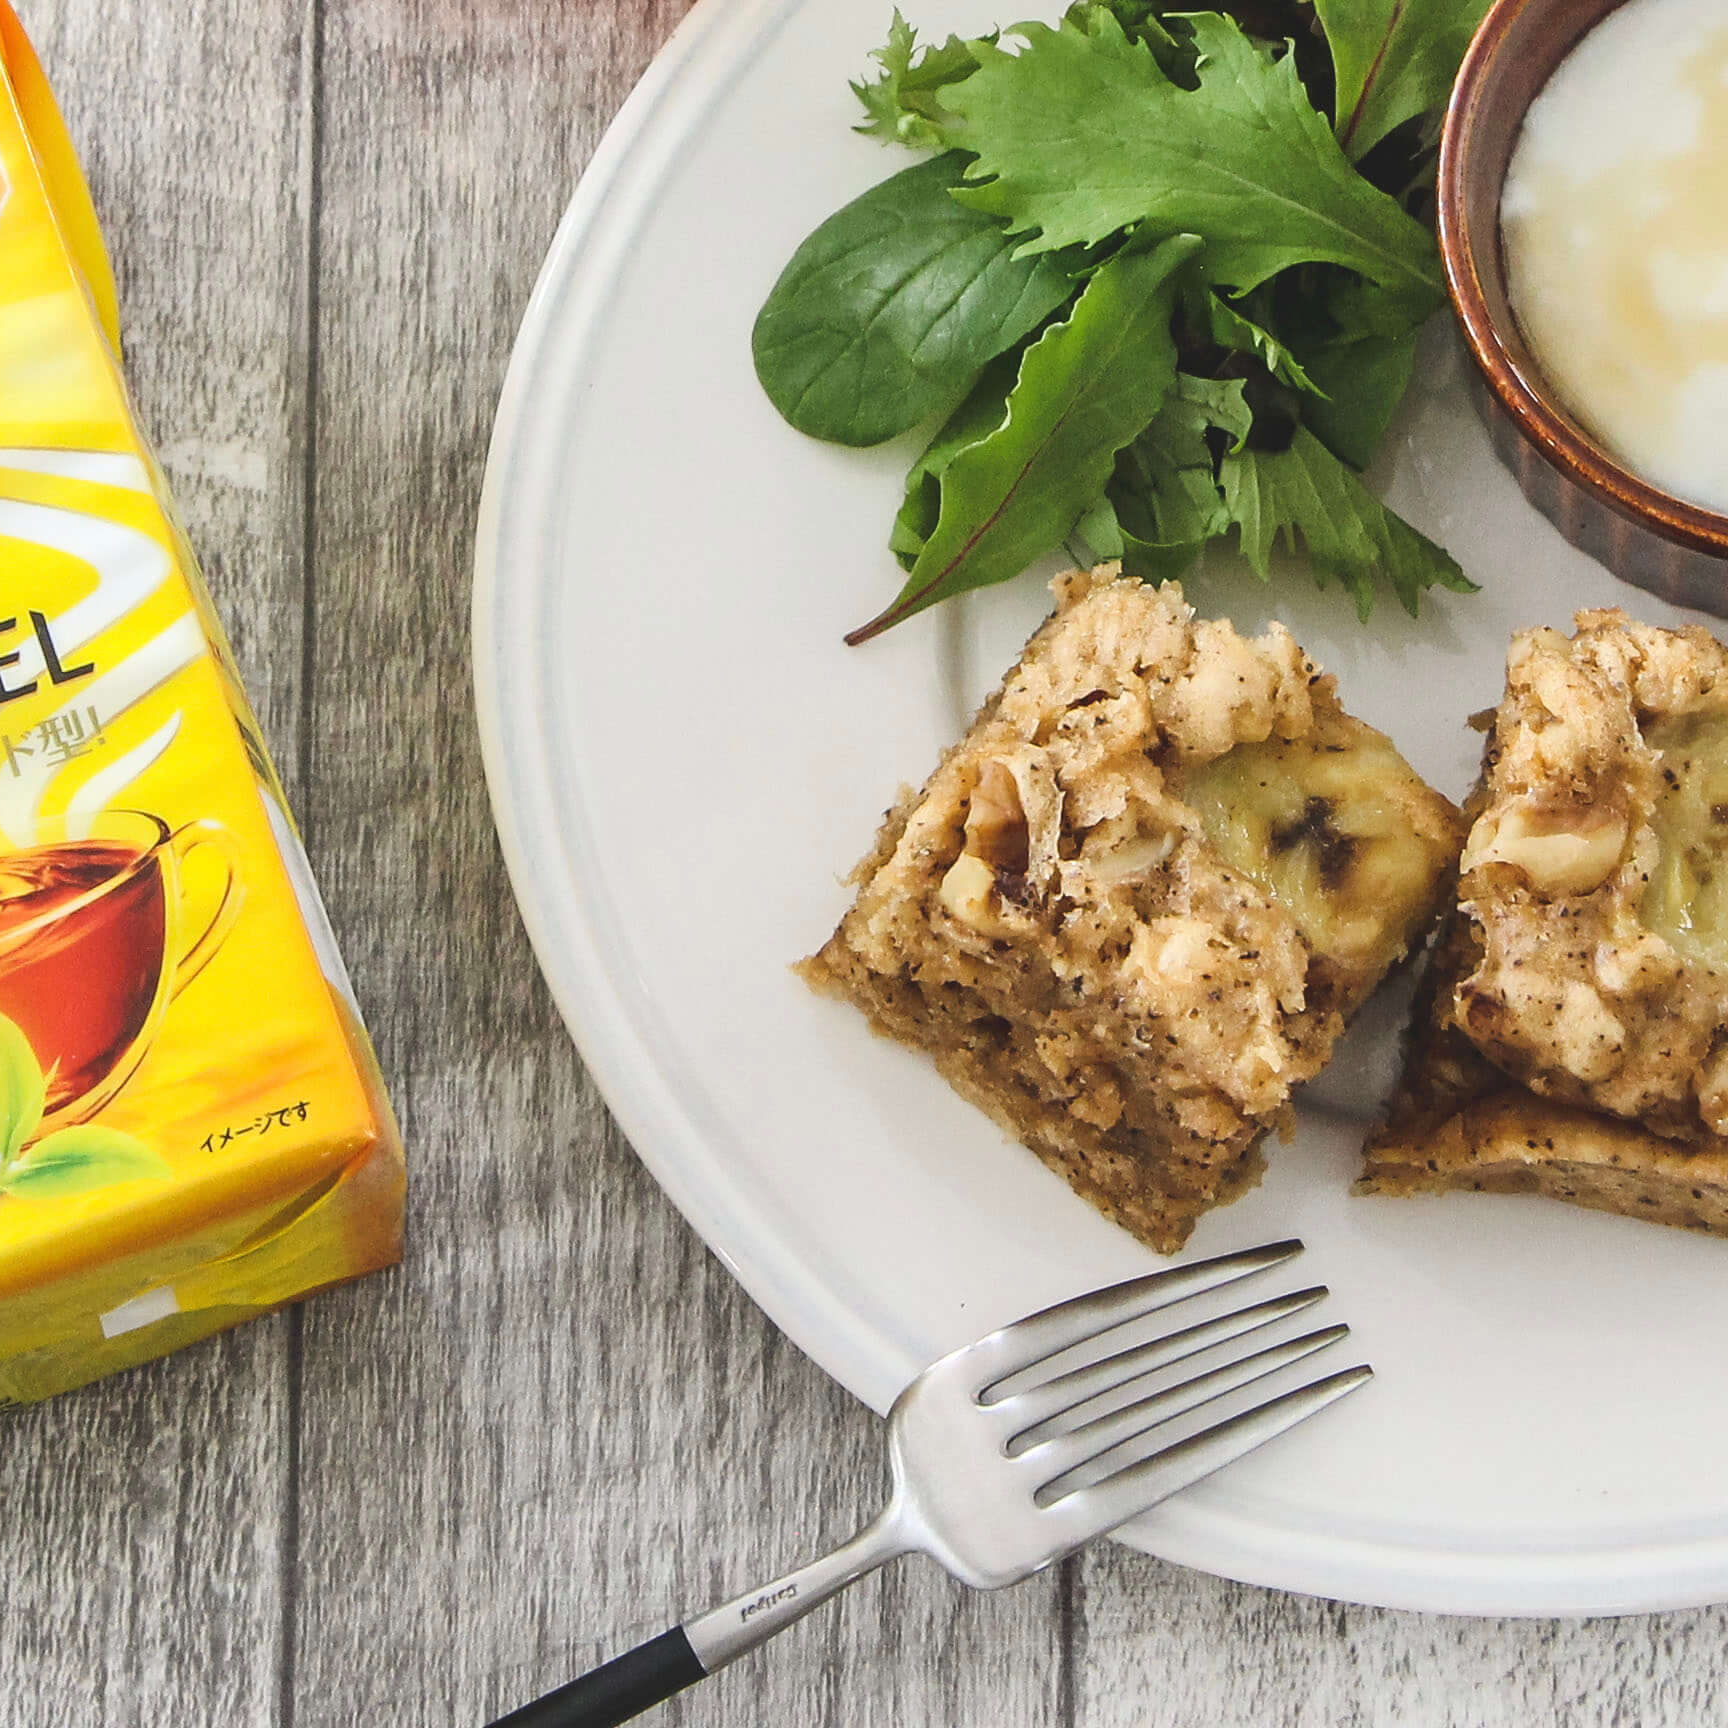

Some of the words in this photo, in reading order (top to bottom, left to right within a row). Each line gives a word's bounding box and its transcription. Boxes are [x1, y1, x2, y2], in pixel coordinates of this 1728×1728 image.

[200, 1100, 310, 1153] イメージです
